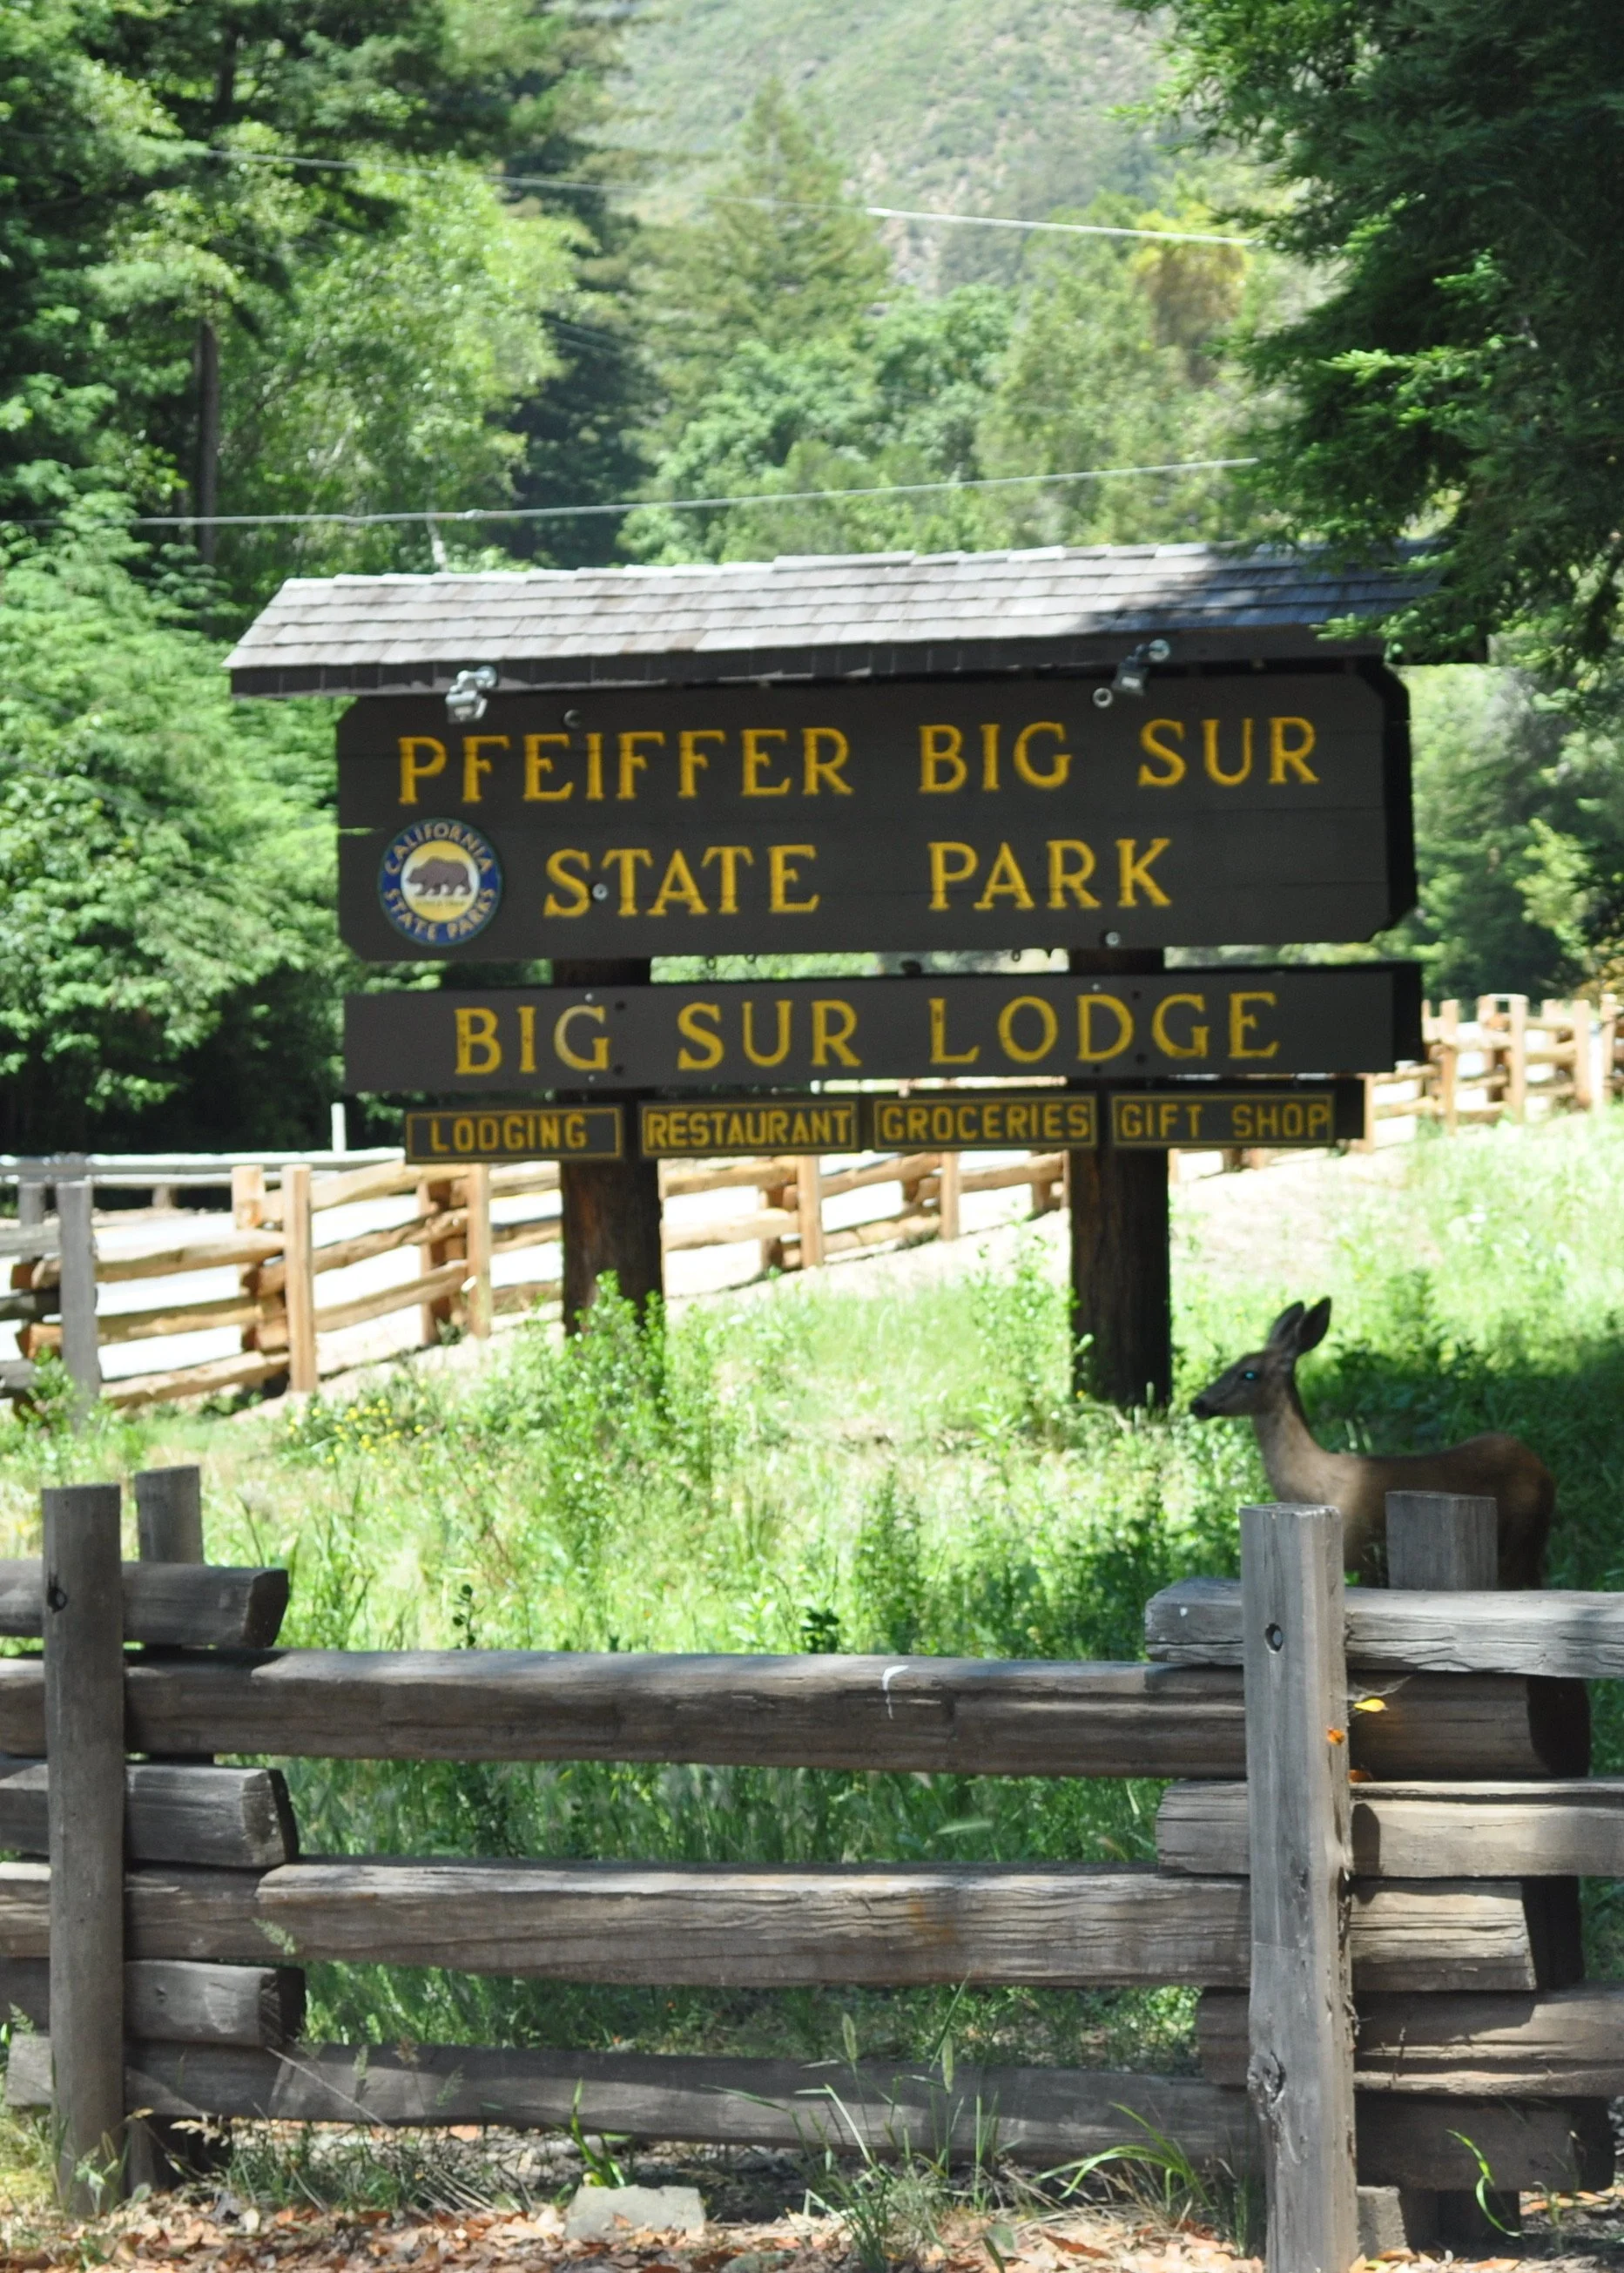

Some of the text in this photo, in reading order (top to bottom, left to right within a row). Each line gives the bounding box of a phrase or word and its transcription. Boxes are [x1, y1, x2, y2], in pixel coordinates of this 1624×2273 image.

[397, 717, 1319, 805] PFEIFFER BIG SUR
[384, 822, 494, 875] CALIFORNIA
[543, 838, 1172, 917] STATE PARK
[384, 887, 495, 941] STATE PARKS
[454, 991, 1281, 1075] BIG SUR LODGE
[430, 1113, 588, 1153] LODGING
[647, 1110, 851, 1149] RESTAURANT
[881, 1103, 1089, 1140] GROCERIES
[1121, 1102, 1328, 1139] GIFT SHOP
